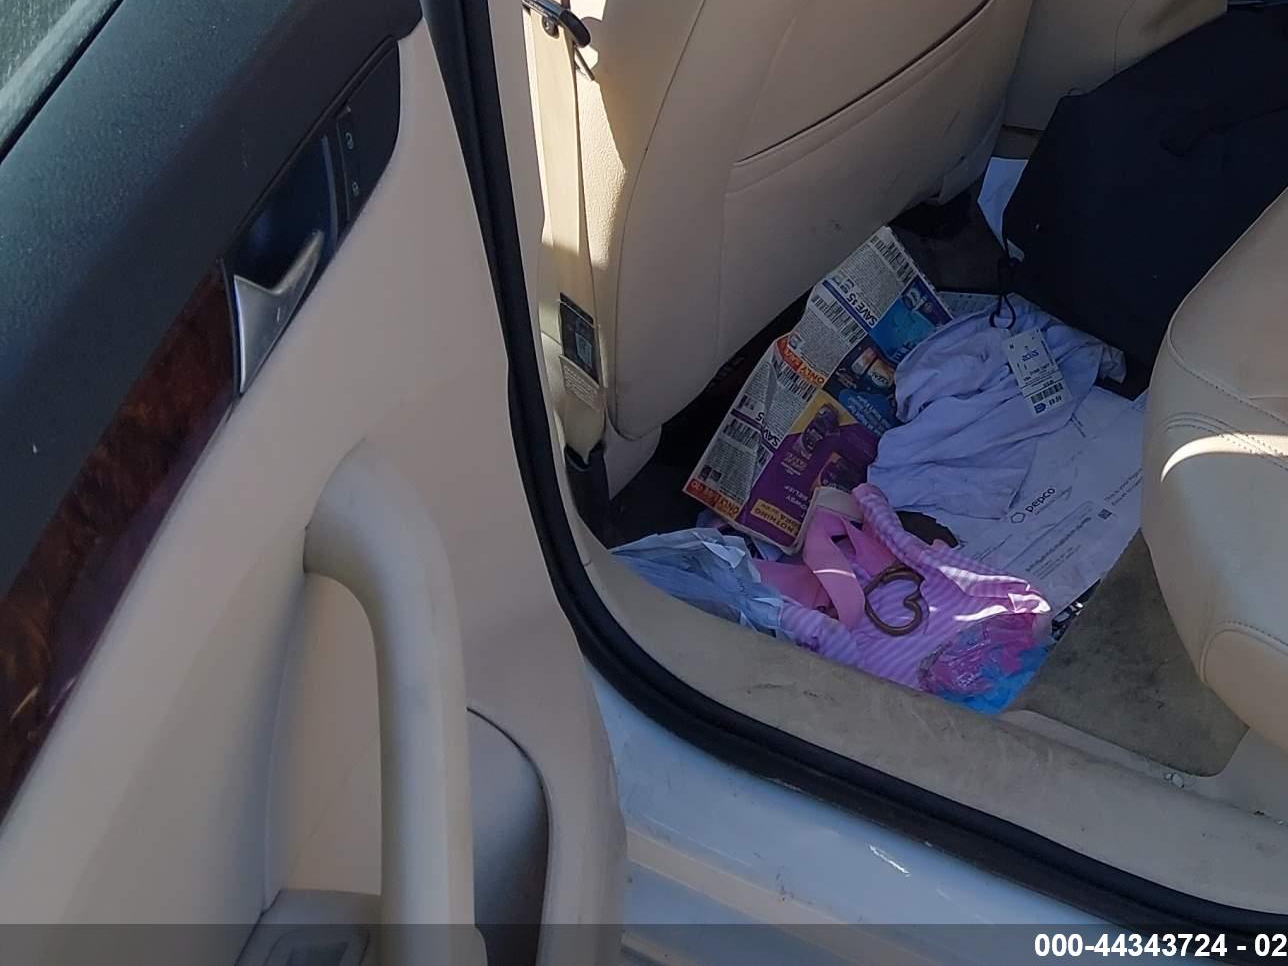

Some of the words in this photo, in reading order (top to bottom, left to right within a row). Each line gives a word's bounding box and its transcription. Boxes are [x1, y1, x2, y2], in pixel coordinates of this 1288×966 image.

[845, 292, 860, 306] $5
[856, 300, 878, 327] SAVE
[799, 364, 825, 386] ONLY
[1024, 487, 1056, 514] pepco
